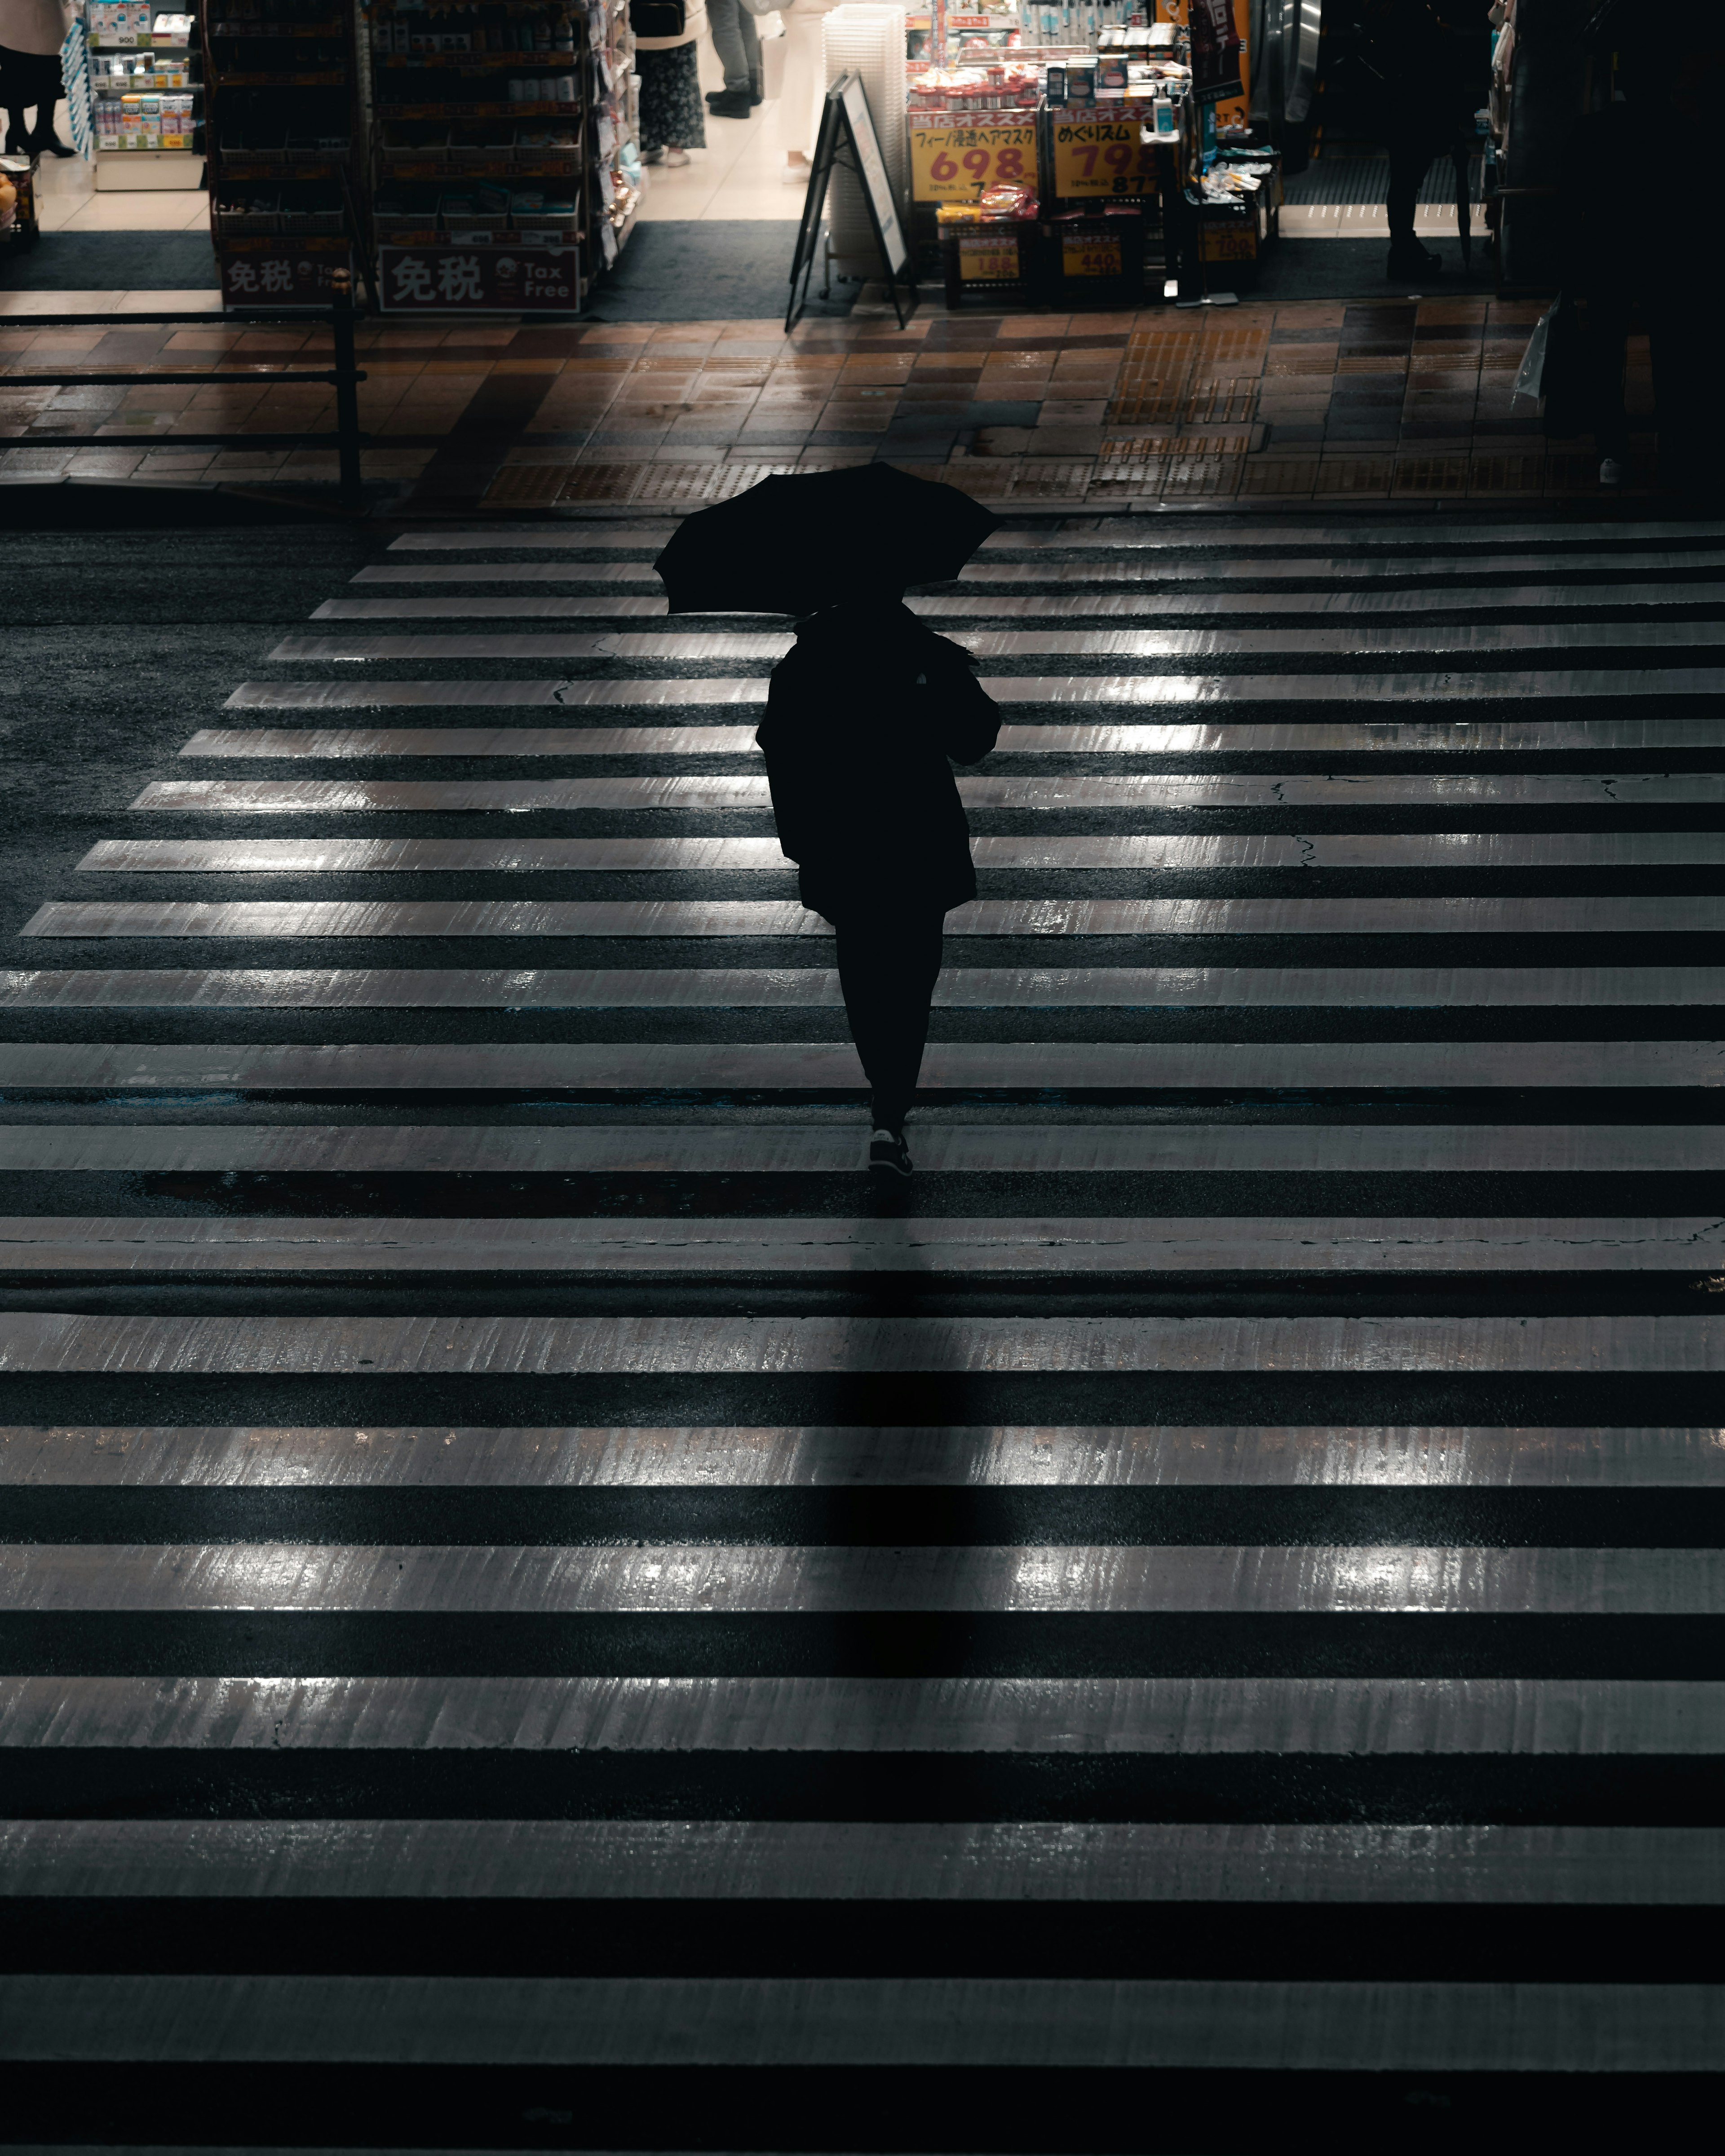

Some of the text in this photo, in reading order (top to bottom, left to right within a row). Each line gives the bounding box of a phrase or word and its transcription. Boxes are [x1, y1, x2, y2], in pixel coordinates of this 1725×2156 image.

[912, 113, 1034, 129] 当店オススメ
[1055, 108, 1153, 123] 当店オスス
[1058, 124, 1131, 142] めぐりズム
[1081, 253, 1115, 268] 440
[227, 259, 295, 293] 免税
[316, 264, 333, 276] Ta
[524, 262, 563, 279] Tax
[317, 276, 332, 287] Fr
[391, 255, 485, 302] 免税
[524, 280, 570, 297] Free
